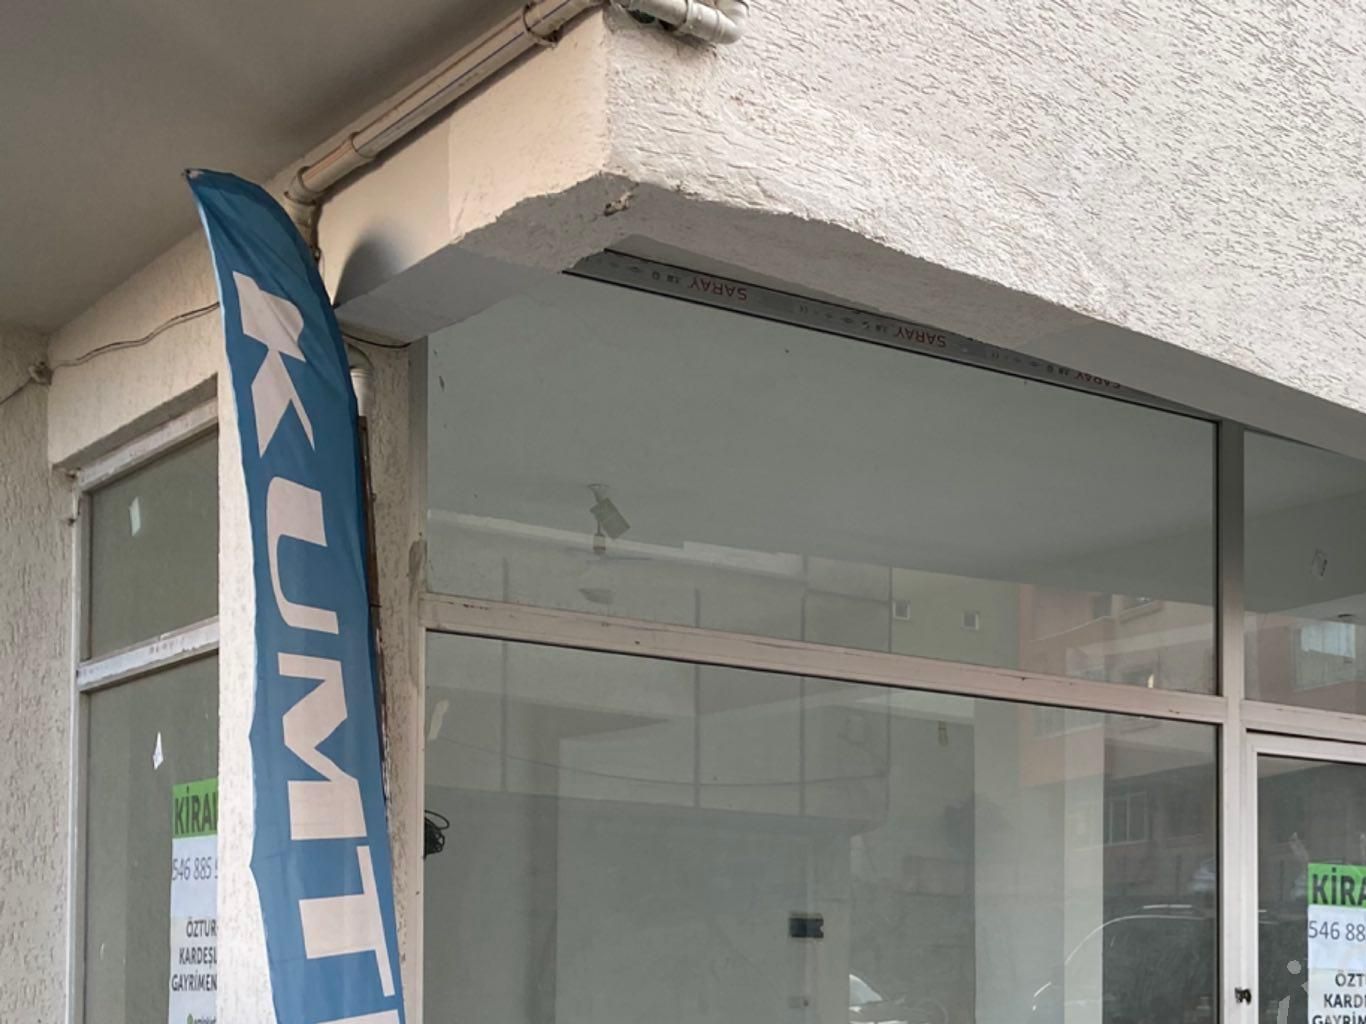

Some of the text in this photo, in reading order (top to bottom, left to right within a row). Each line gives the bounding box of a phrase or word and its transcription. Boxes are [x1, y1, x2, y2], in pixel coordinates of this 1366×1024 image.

[688, 276, 748, 300] SARAY
[897, 325, 947, 348] SARAY
[193, 857, 212, 880] 885
[1308, 920, 1340, 939] 546
